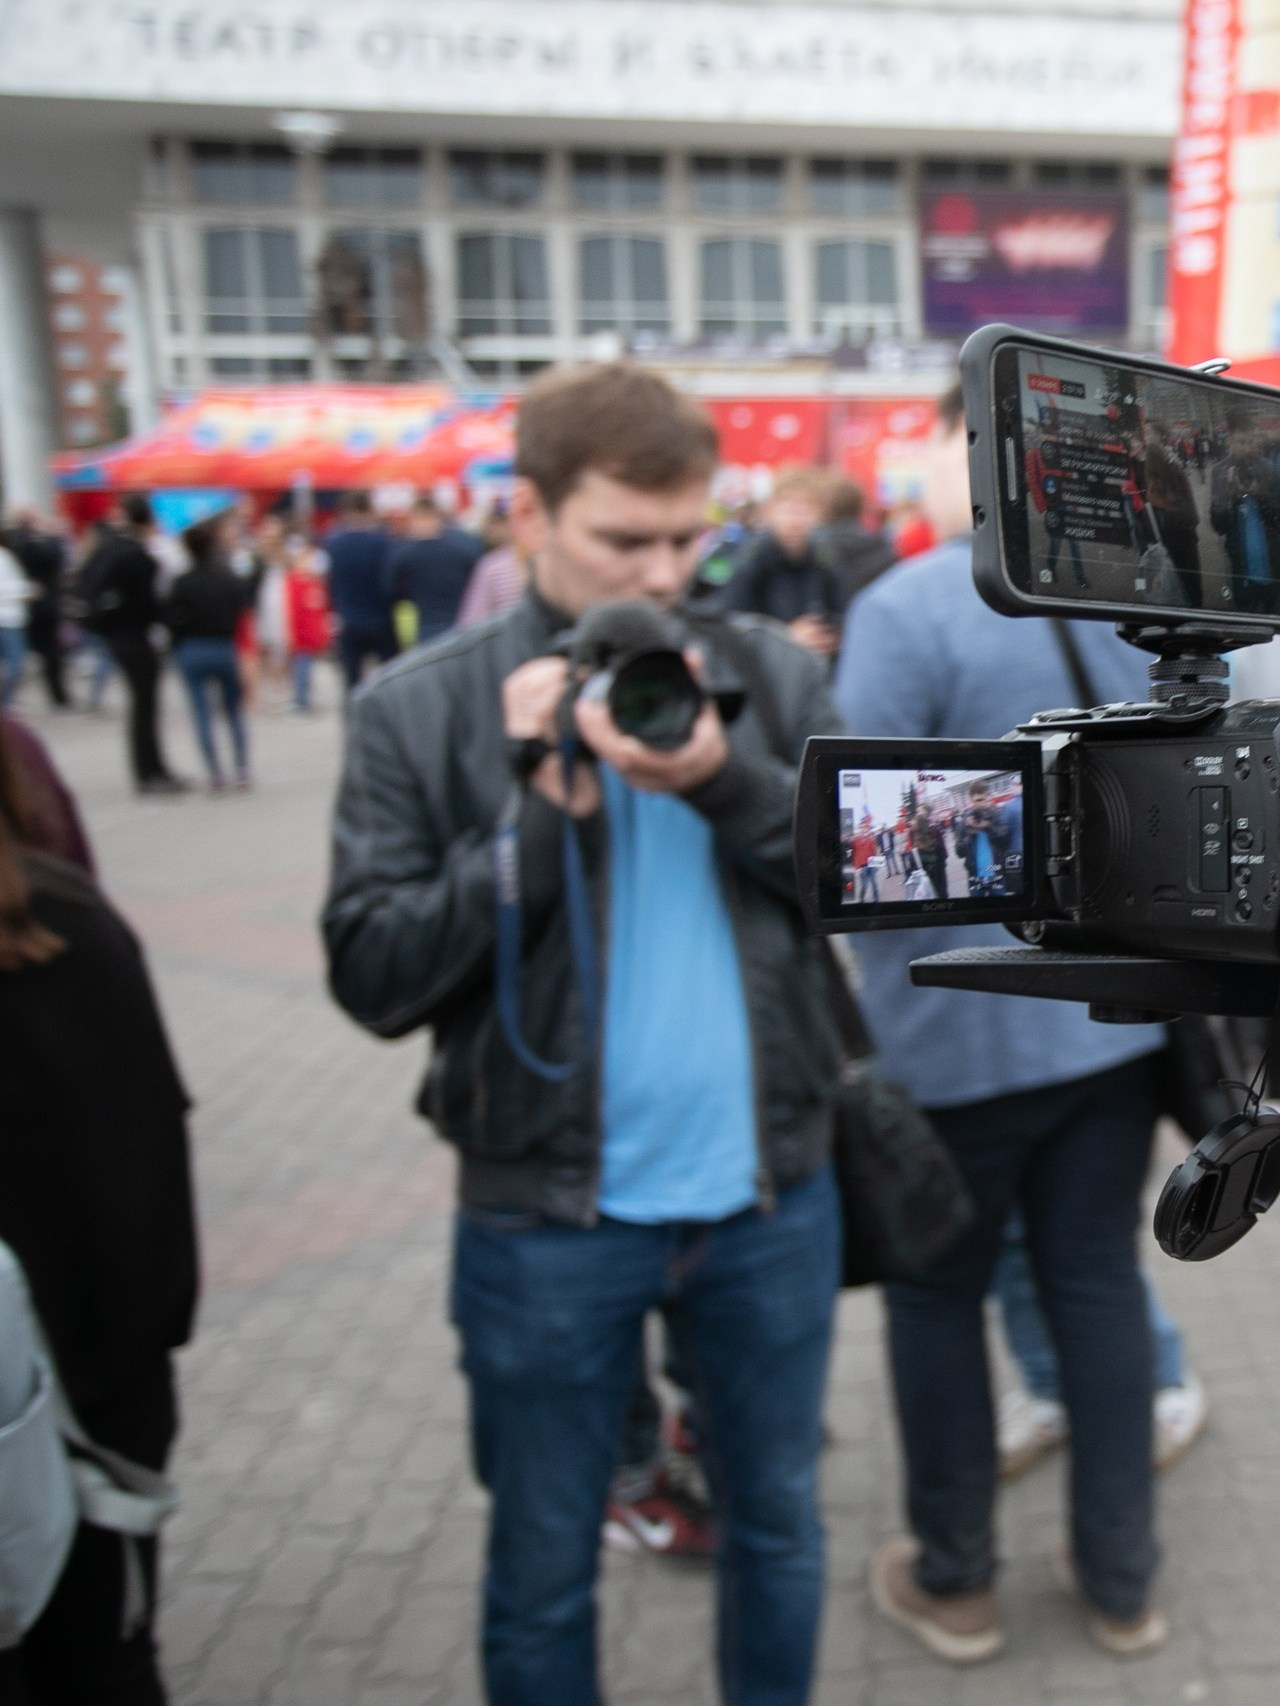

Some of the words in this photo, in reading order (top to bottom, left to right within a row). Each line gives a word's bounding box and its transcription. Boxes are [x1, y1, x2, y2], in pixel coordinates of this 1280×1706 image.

[128, 12, 324, 64] ТЕАТР
[354, 20, 579, 72] ОПЕРЫ
[920, 901, 954, 912] SONY
